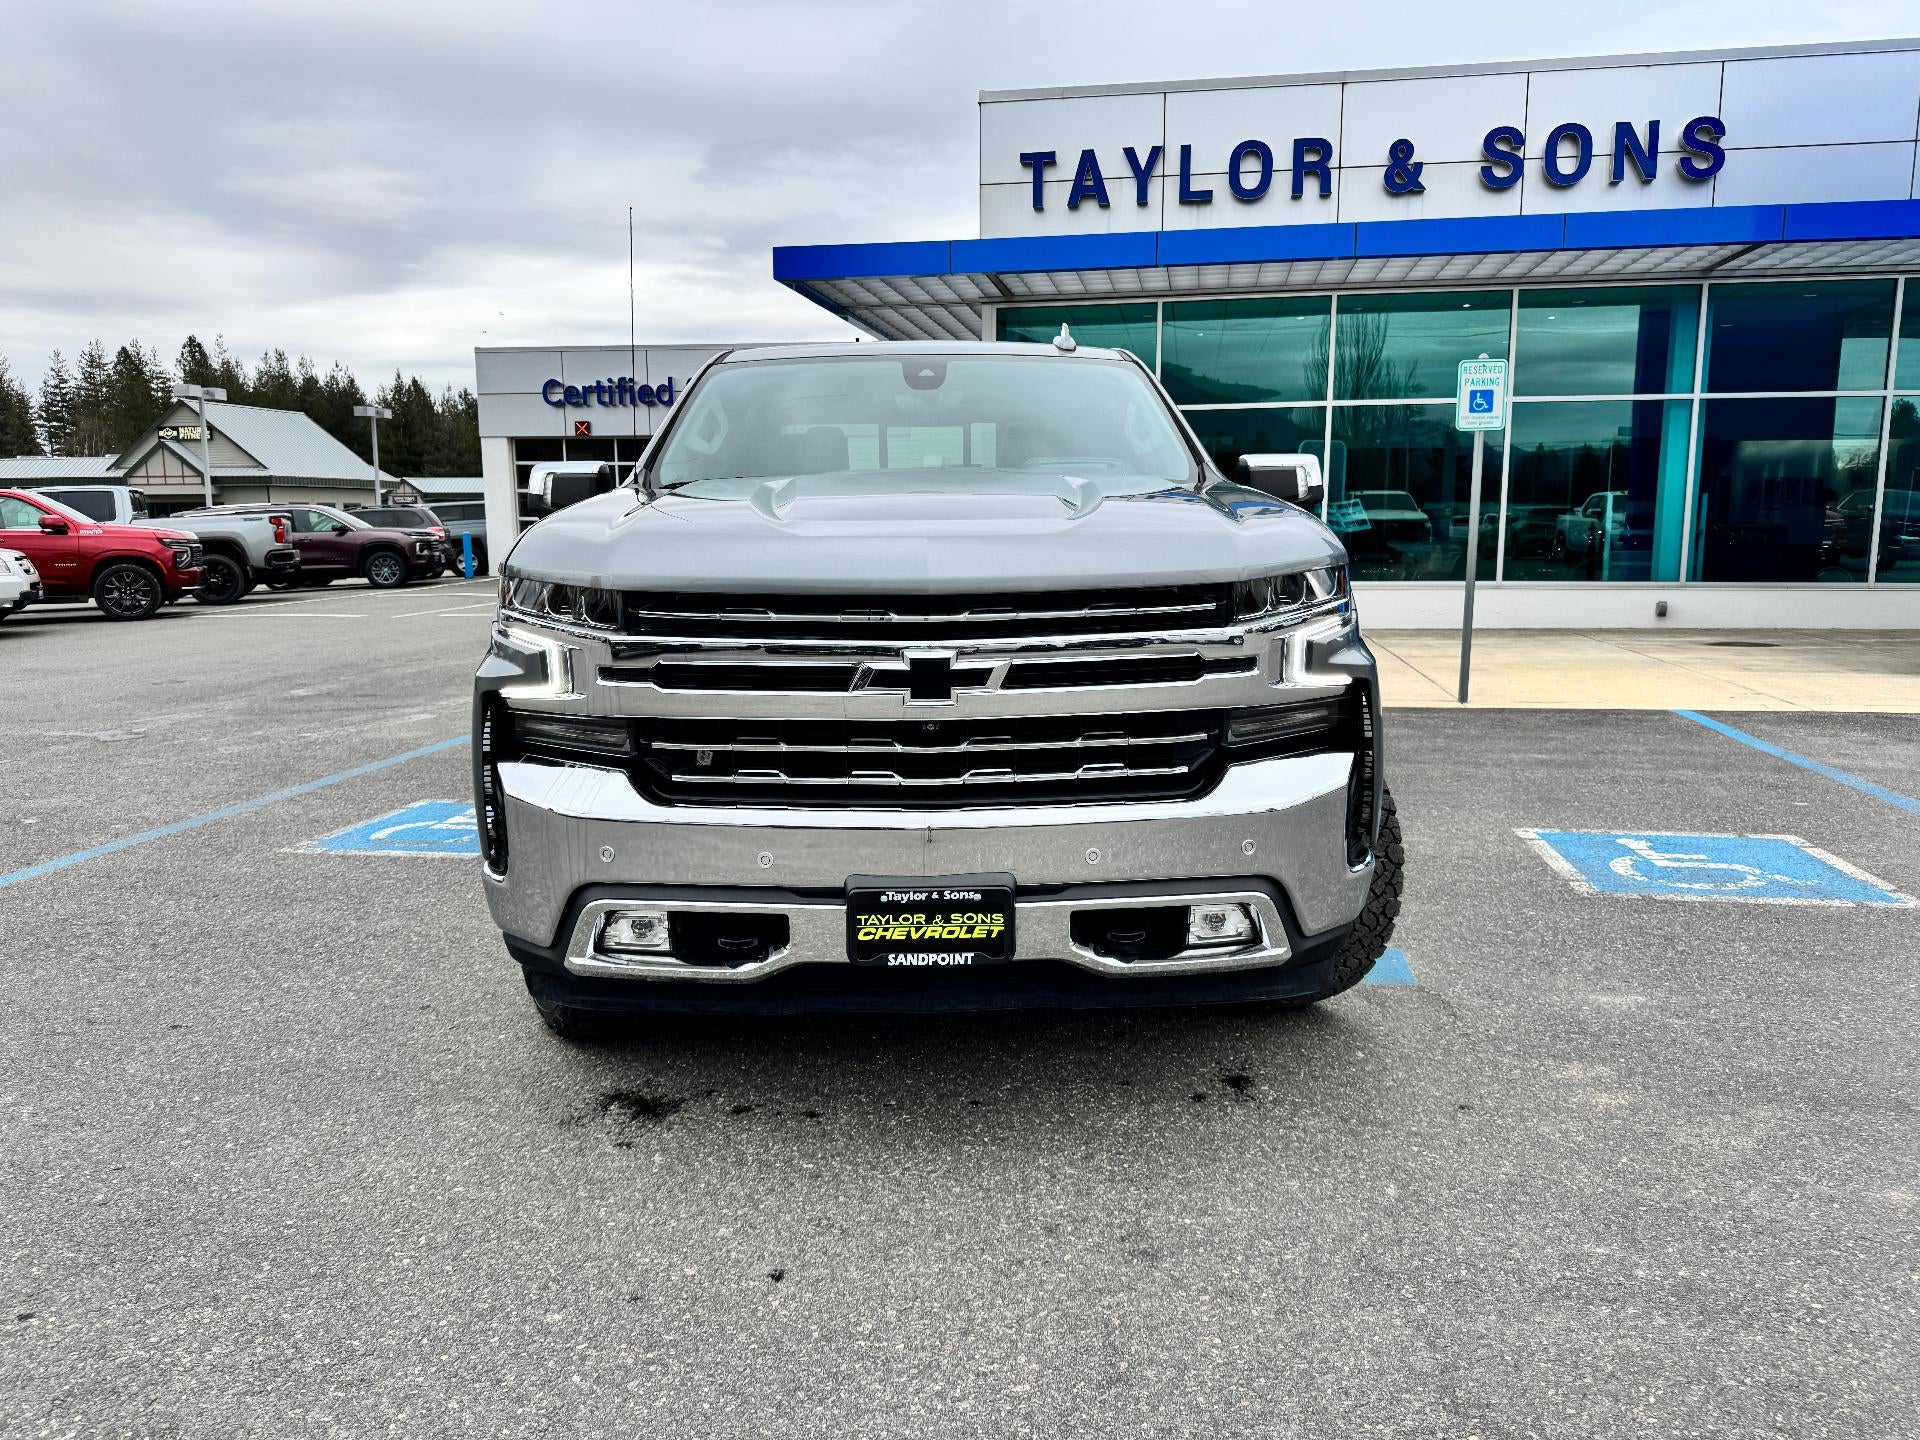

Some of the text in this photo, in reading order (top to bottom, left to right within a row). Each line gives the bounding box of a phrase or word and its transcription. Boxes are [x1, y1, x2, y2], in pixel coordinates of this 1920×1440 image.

[1019, 116, 1726, 211] TAYLOR & SONS
[1463, 365, 1503, 375] RESERVED
[1464, 377, 1500, 387] PARKING
[542, 376, 674, 408] Certified
[179, 432, 210, 440] FITNES
[886, 891, 928, 903] Taylor
[943, 890, 975, 900] Sons
[857, 912, 1004, 926] TAYLOR & SONS
[857, 925, 1005, 941] CHEVROLET
[888, 952, 975, 966] SANDPOINT
